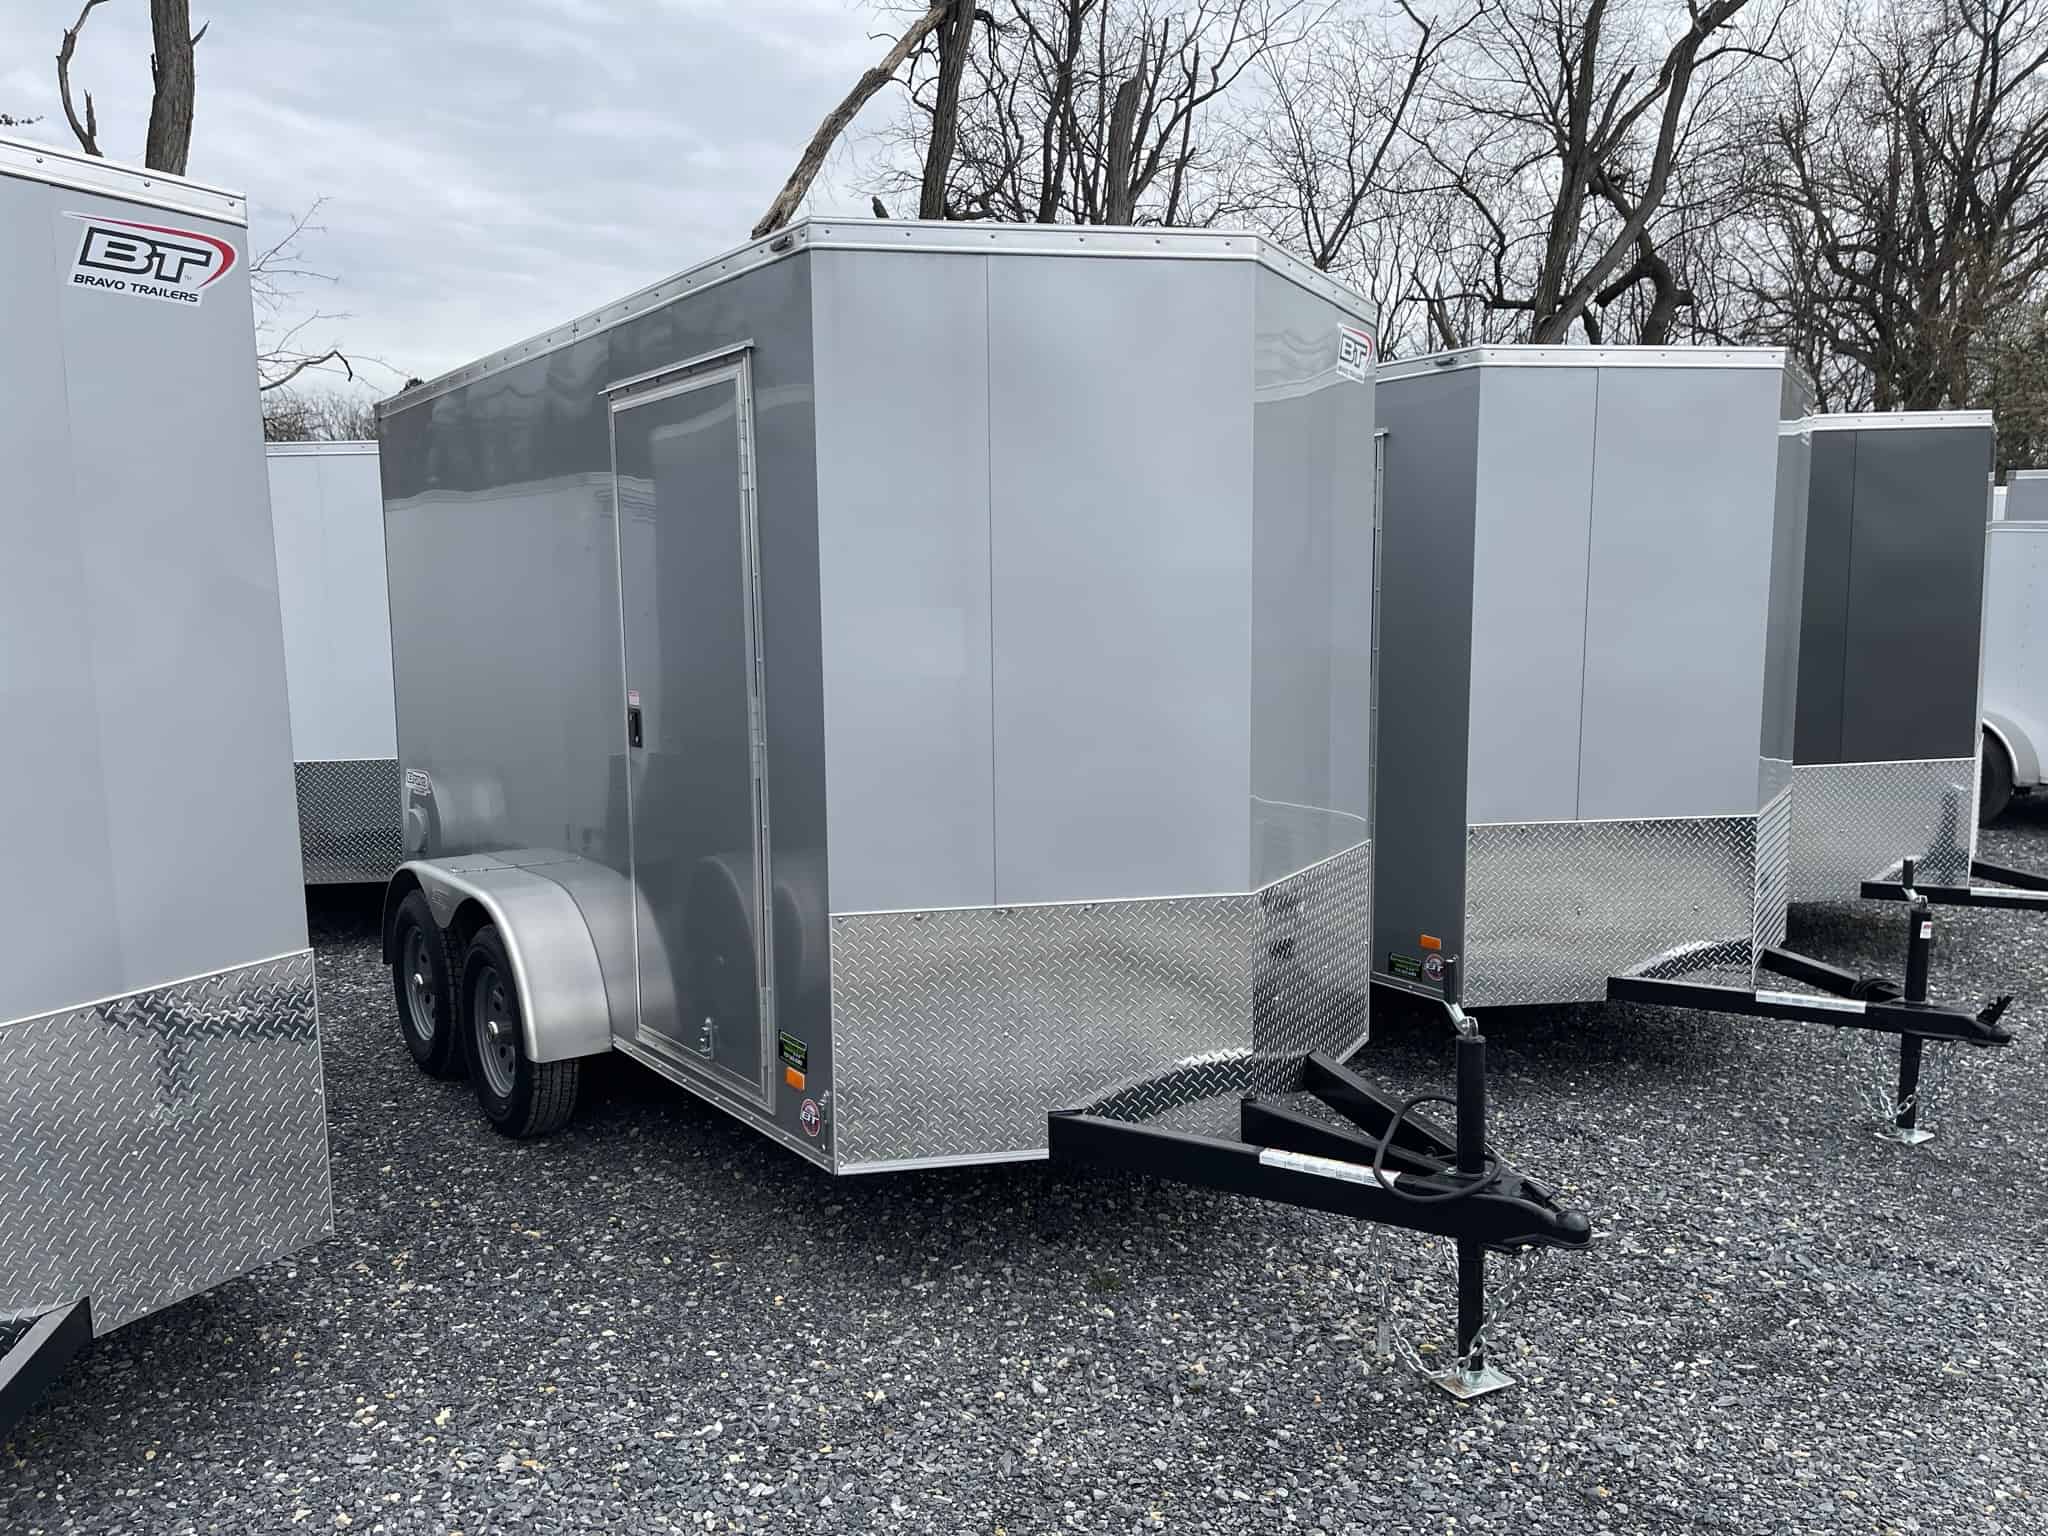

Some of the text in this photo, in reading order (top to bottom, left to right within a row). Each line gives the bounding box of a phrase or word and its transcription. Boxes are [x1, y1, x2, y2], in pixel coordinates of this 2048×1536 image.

[78, 226, 213, 283] BT
[73, 273, 199, 303] BRAVO TRAILERS
[1339, 333, 1368, 368] BT
